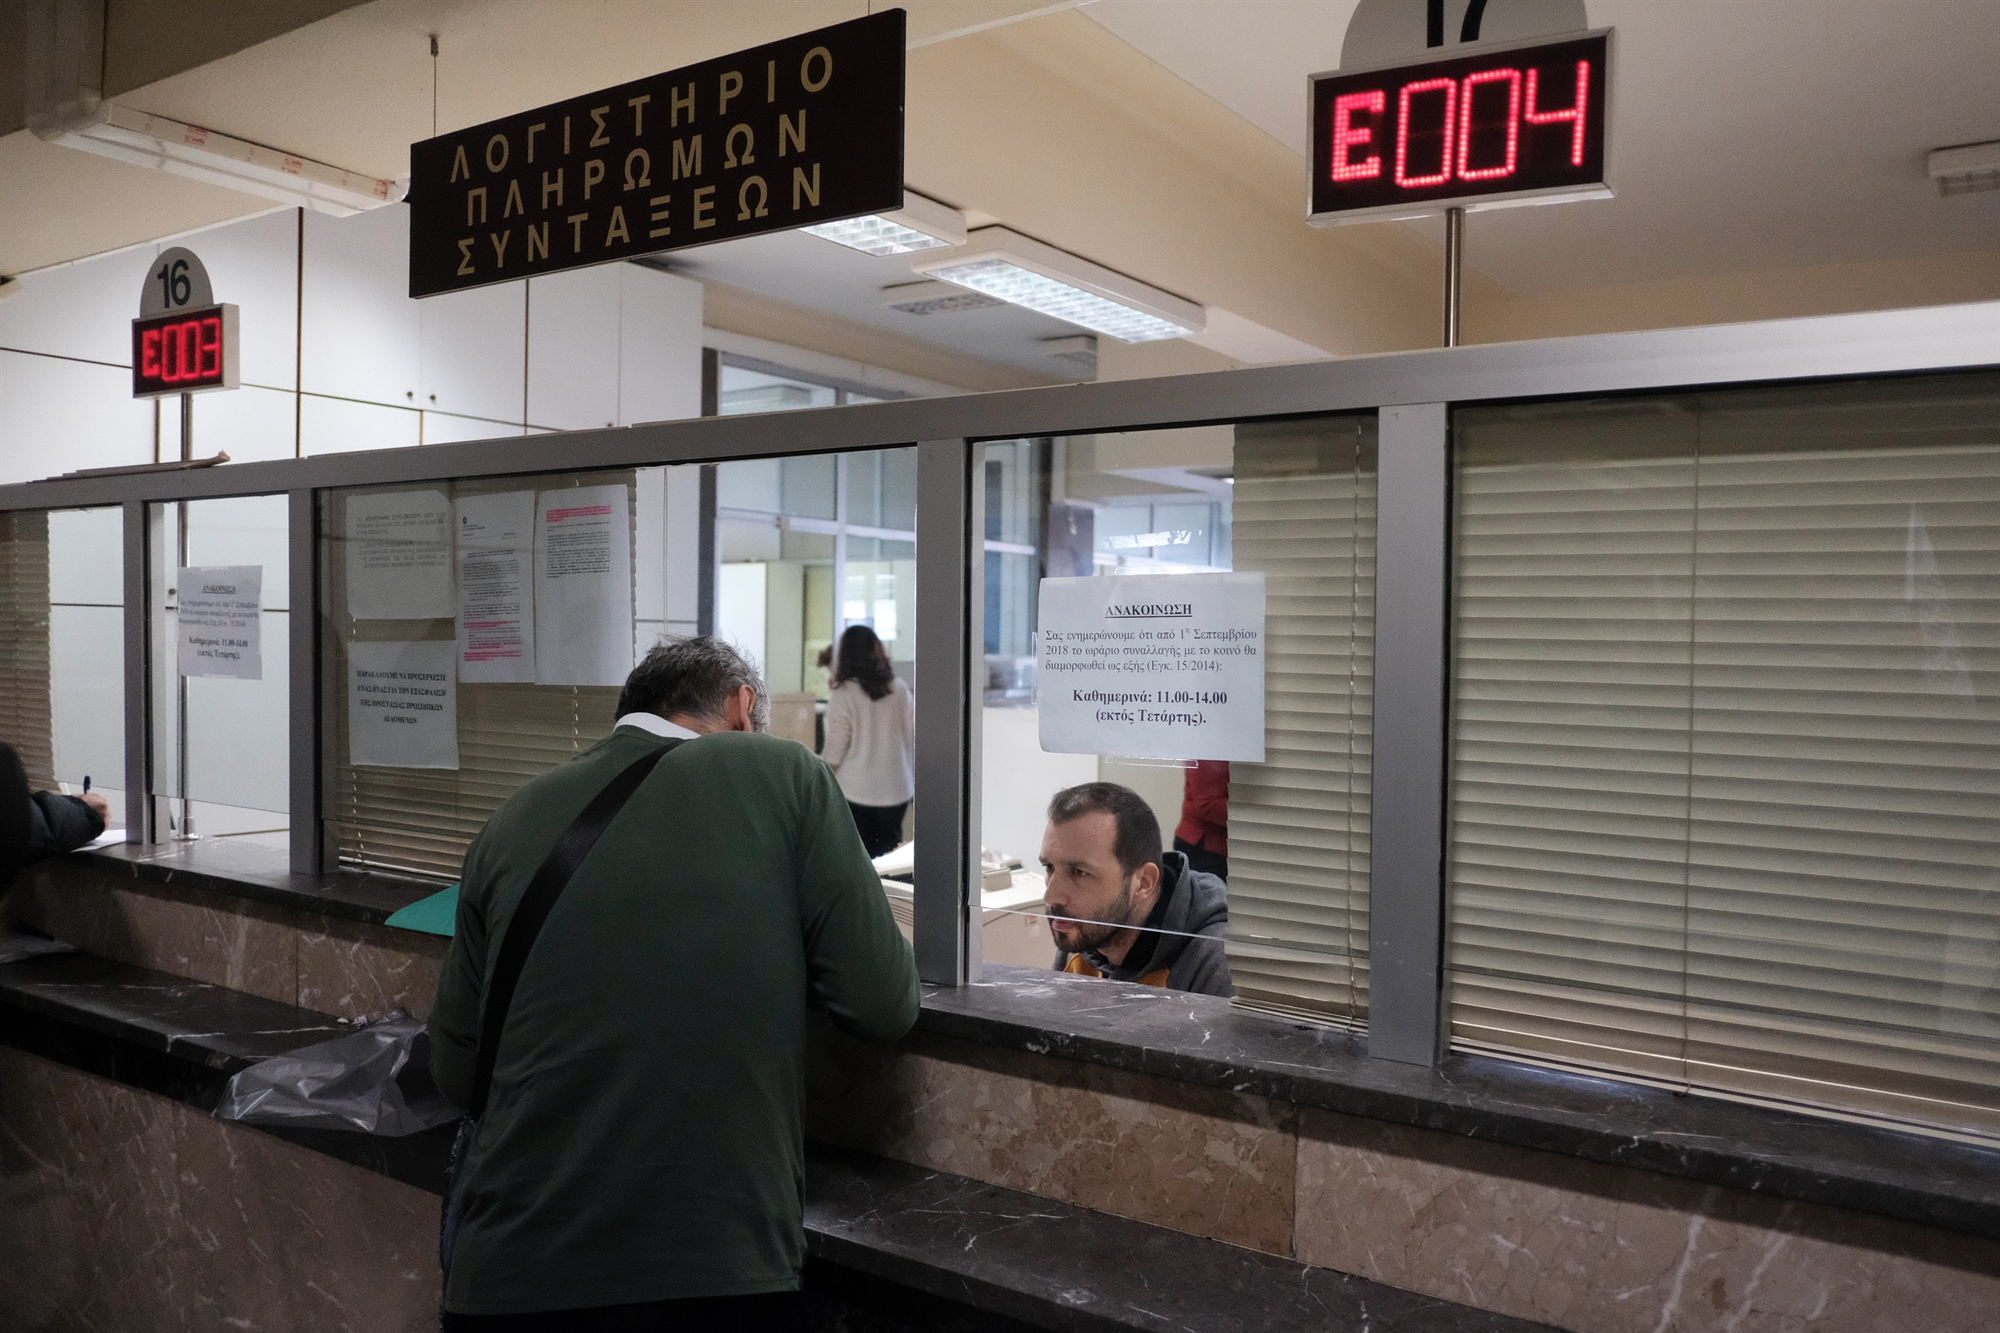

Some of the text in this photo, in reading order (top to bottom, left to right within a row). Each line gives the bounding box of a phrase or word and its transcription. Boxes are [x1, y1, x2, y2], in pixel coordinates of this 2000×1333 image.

[450, 46, 833, 183] ΛΟΓΙΣΤΗΡΙΟ
[1331, 60, 1590, 188] E004
[466, 109, 807, 226] ΠΛΗΡΩΜΩΝ
[456, 163, 821, 276] ΣΥΝΤΑΞΕΩΝ
[157, 259, 191, 309] 16
[142, 317, 221, 382] E003
[1105, 604, 1192, 617] ΑΝΑΚΟΙΝΩΣΗ
[1045, 630, 1063, 642] Σας
[1066, 629, 1136, 642] ενημερώνουμε
[1138, 628, 1153, 640] ότι
[1157, 629, 1176, 640] από
[1193, 628, 1257, 641] Σεπτεμβρίου
[1045, 644, 1257, 657] 2018 το ωράριο συναλλαγής με το κοινό θα
[1045, 660, 1223, 673] διαμορφωθεί ως εξής (Εγκ. 15/2014):
[1073, 689, 1227, 705] Καθημερινά: 11.00-14.00
[1096, 709, 1207, 727] (εκτός Τετάρτης).
